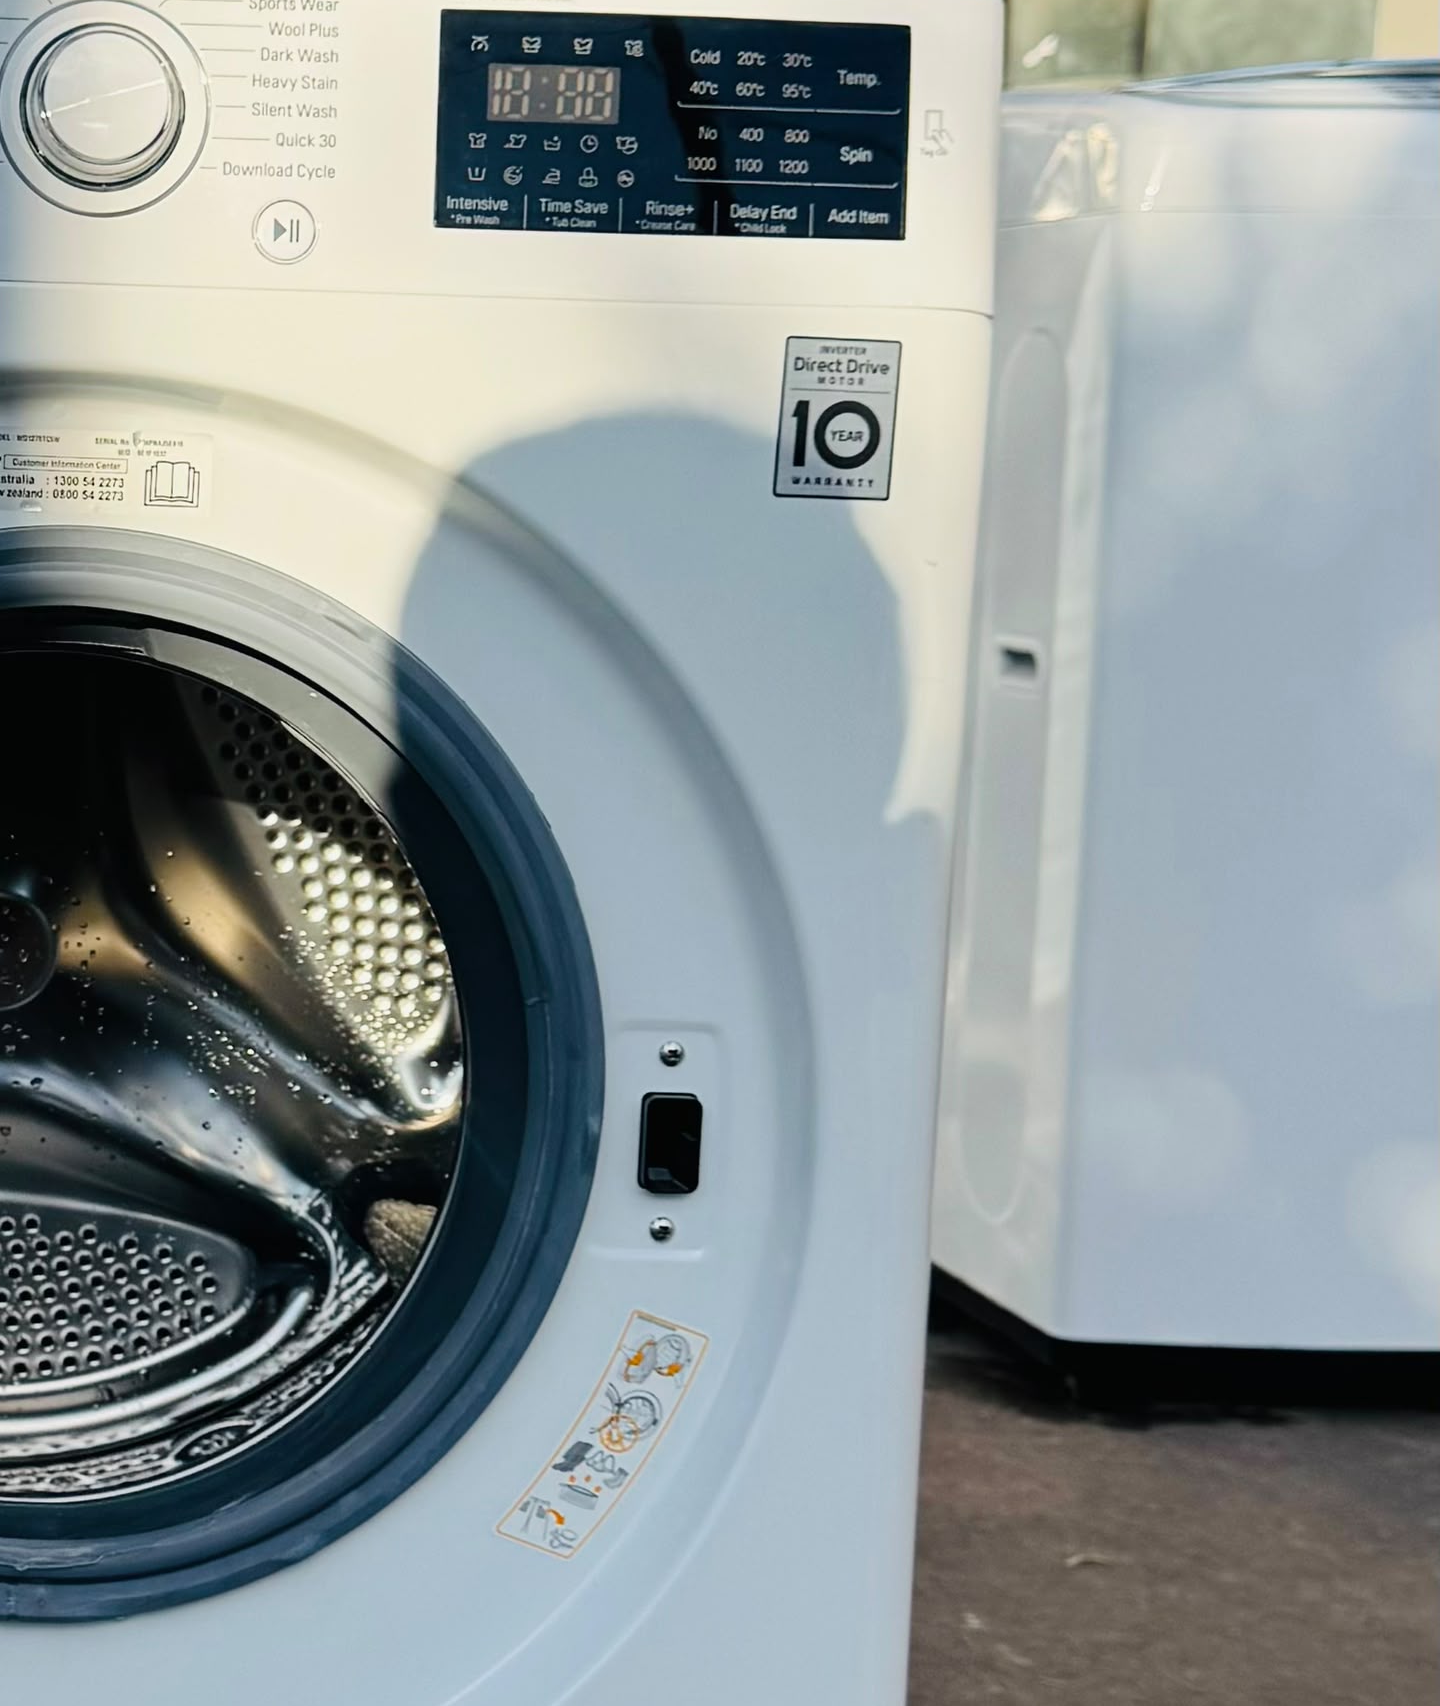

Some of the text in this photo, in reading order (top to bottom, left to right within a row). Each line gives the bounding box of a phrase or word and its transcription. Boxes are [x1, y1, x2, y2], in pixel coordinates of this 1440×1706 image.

[268, 21, 339, 38] Wool Plus
[260, 46, 339, 63] Dark Wash
[690, 49, 721, 65] Cold
[252, 73, 339, 92] Heavy Stain
[836, 69, 882, 89] Temp.
[251, 102, 338, 118] Silent Wash
[275, 132, 337, 149] Quick 30
[698, 126, 810, 143] No 400 800
[839, 146, 873, 165] Spin
[222, 161, 336, 180] Download Cycle
[687, 156, 809, 174] 1000 1100 1200
[446, 195, 509, 211] Intensive
[539, 197, 609, 214] Time Save
[645, 200, 695, 216] Rinse+
[473, 215, 500, 225] Wash
[730, 203, 797, 222] Delay End
[827, 208, 890, 224] Add Item
[570, 218, 597, 228] Clean
[793, 356, 891, 375] Direct Drive
[817, 376, 865, 386] MOTOR
[792, 399, 881, 470] 10
[830, 429, 864, 442] YEAR
[12, 457, 49, 468] Customer
[51, 458, 94, 469] Information
[54, 476, 79, 486] 1300
[83, 476, 95, 486] 54
[99, 477, 124, 488] 2273
[791, 476, 875, 488] WARRANTY
[6, 488, 43, 499] zealand
[52, 489, 79, 500] 0800
[82, 489, 95, 500] 54
[98, 490, 124, 501] 2273
